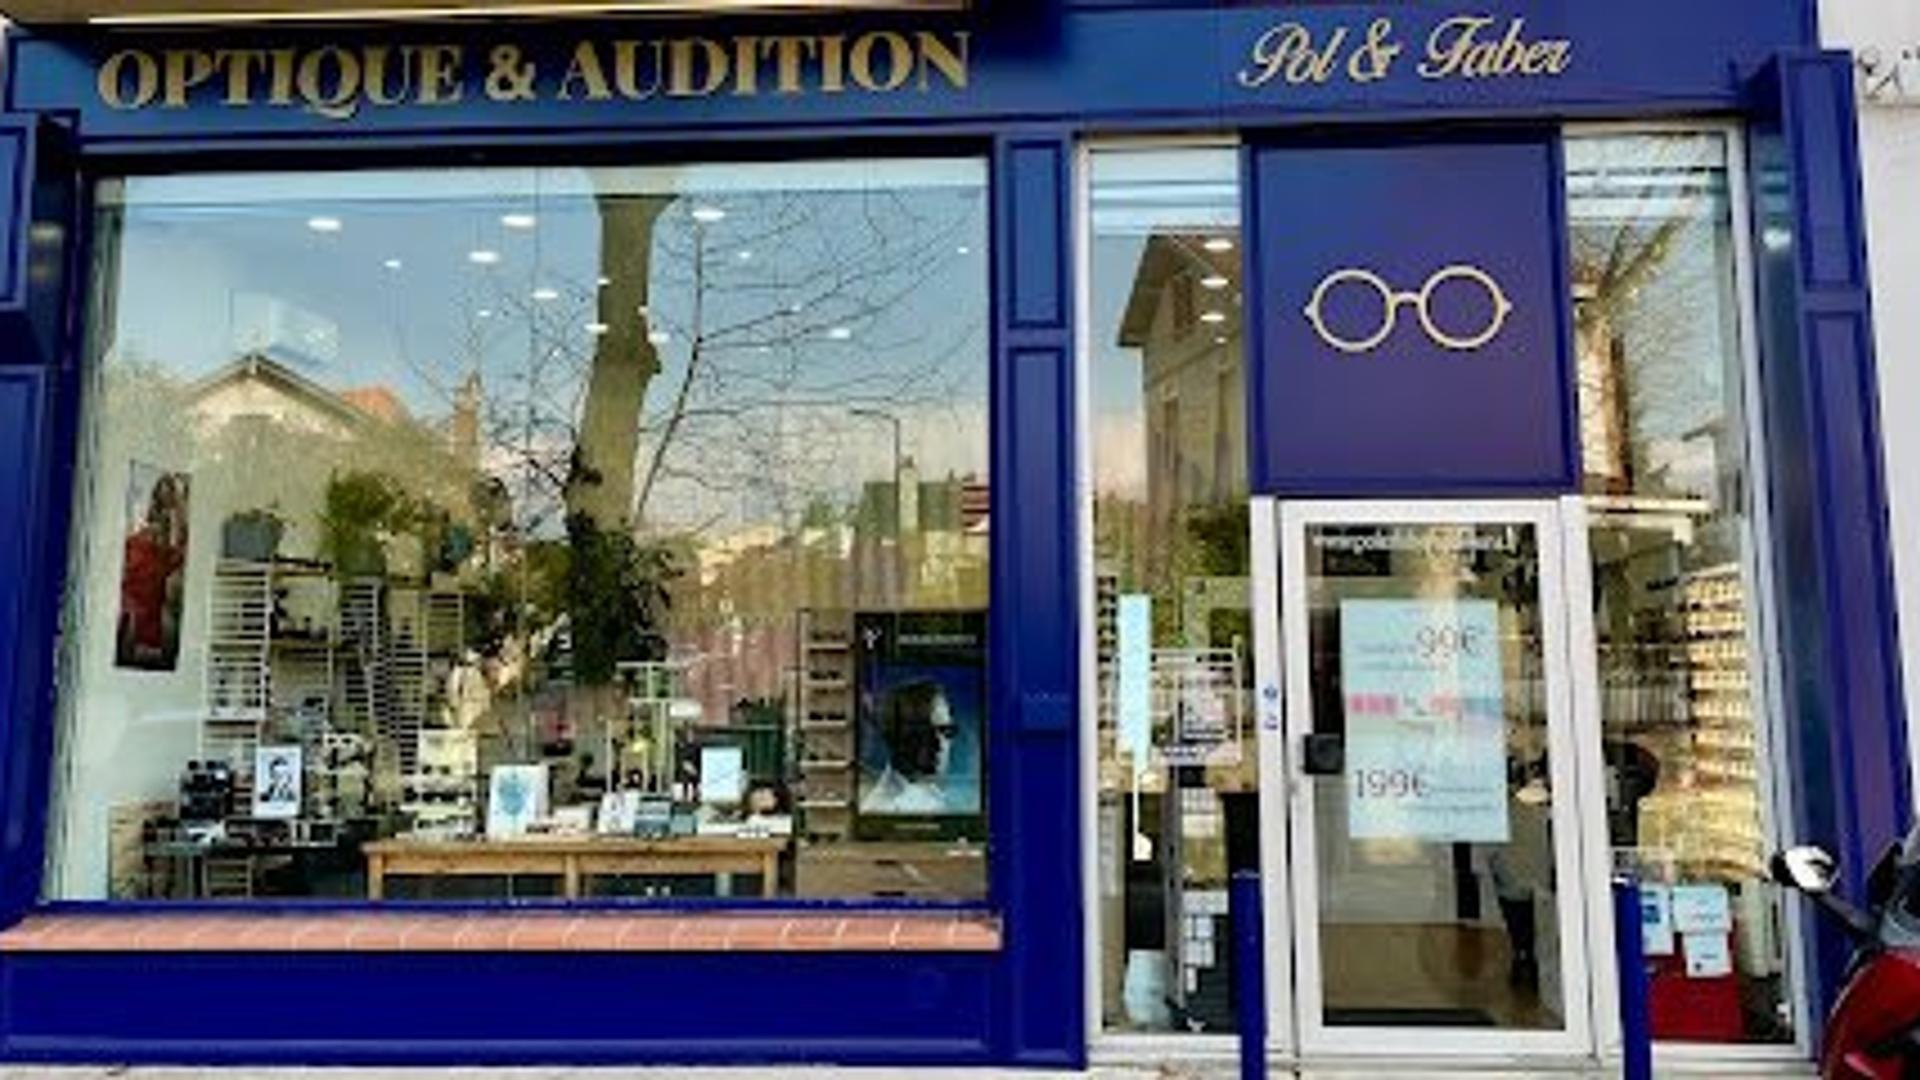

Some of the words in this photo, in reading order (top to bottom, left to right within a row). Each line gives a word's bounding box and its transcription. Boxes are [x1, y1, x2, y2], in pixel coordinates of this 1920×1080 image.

[98, 45, 464, 119] OPTIQUE
[483, 45, 538, 101] &
[558, 30, 971, 101] AUDITION
[1238, 20, 1344, 87] Pol
[1348, 17, 1401, 81] &
[1416, 624, 1478, 659] 99€
[1353, 768, 1431, 799] 199€
